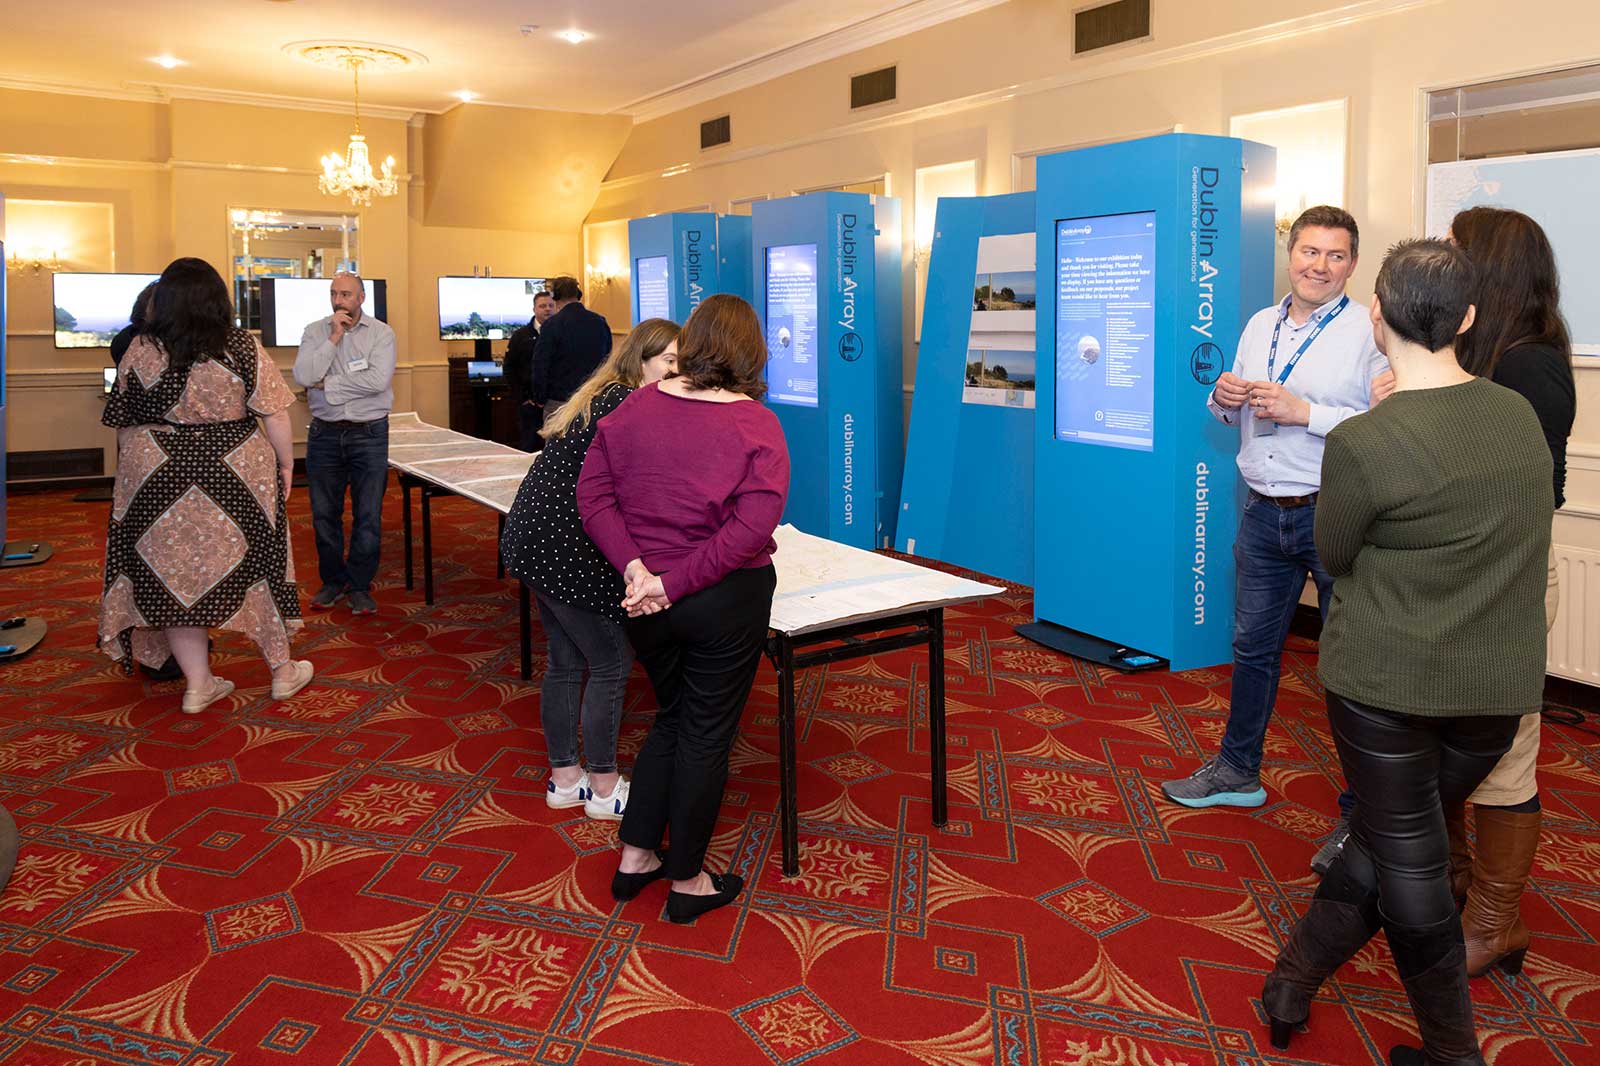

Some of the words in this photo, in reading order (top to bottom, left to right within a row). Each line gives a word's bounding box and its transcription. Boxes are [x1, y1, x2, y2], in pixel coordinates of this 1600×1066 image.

[1191, 166, 1199, 216] Generation
[1191, 217, 1199, 229] for
[1190, 230, 1198, 282] generations
[842, 413, 854, 525] dublinarray.com
[1192, 462, 1210, 625] dublinarray.com
